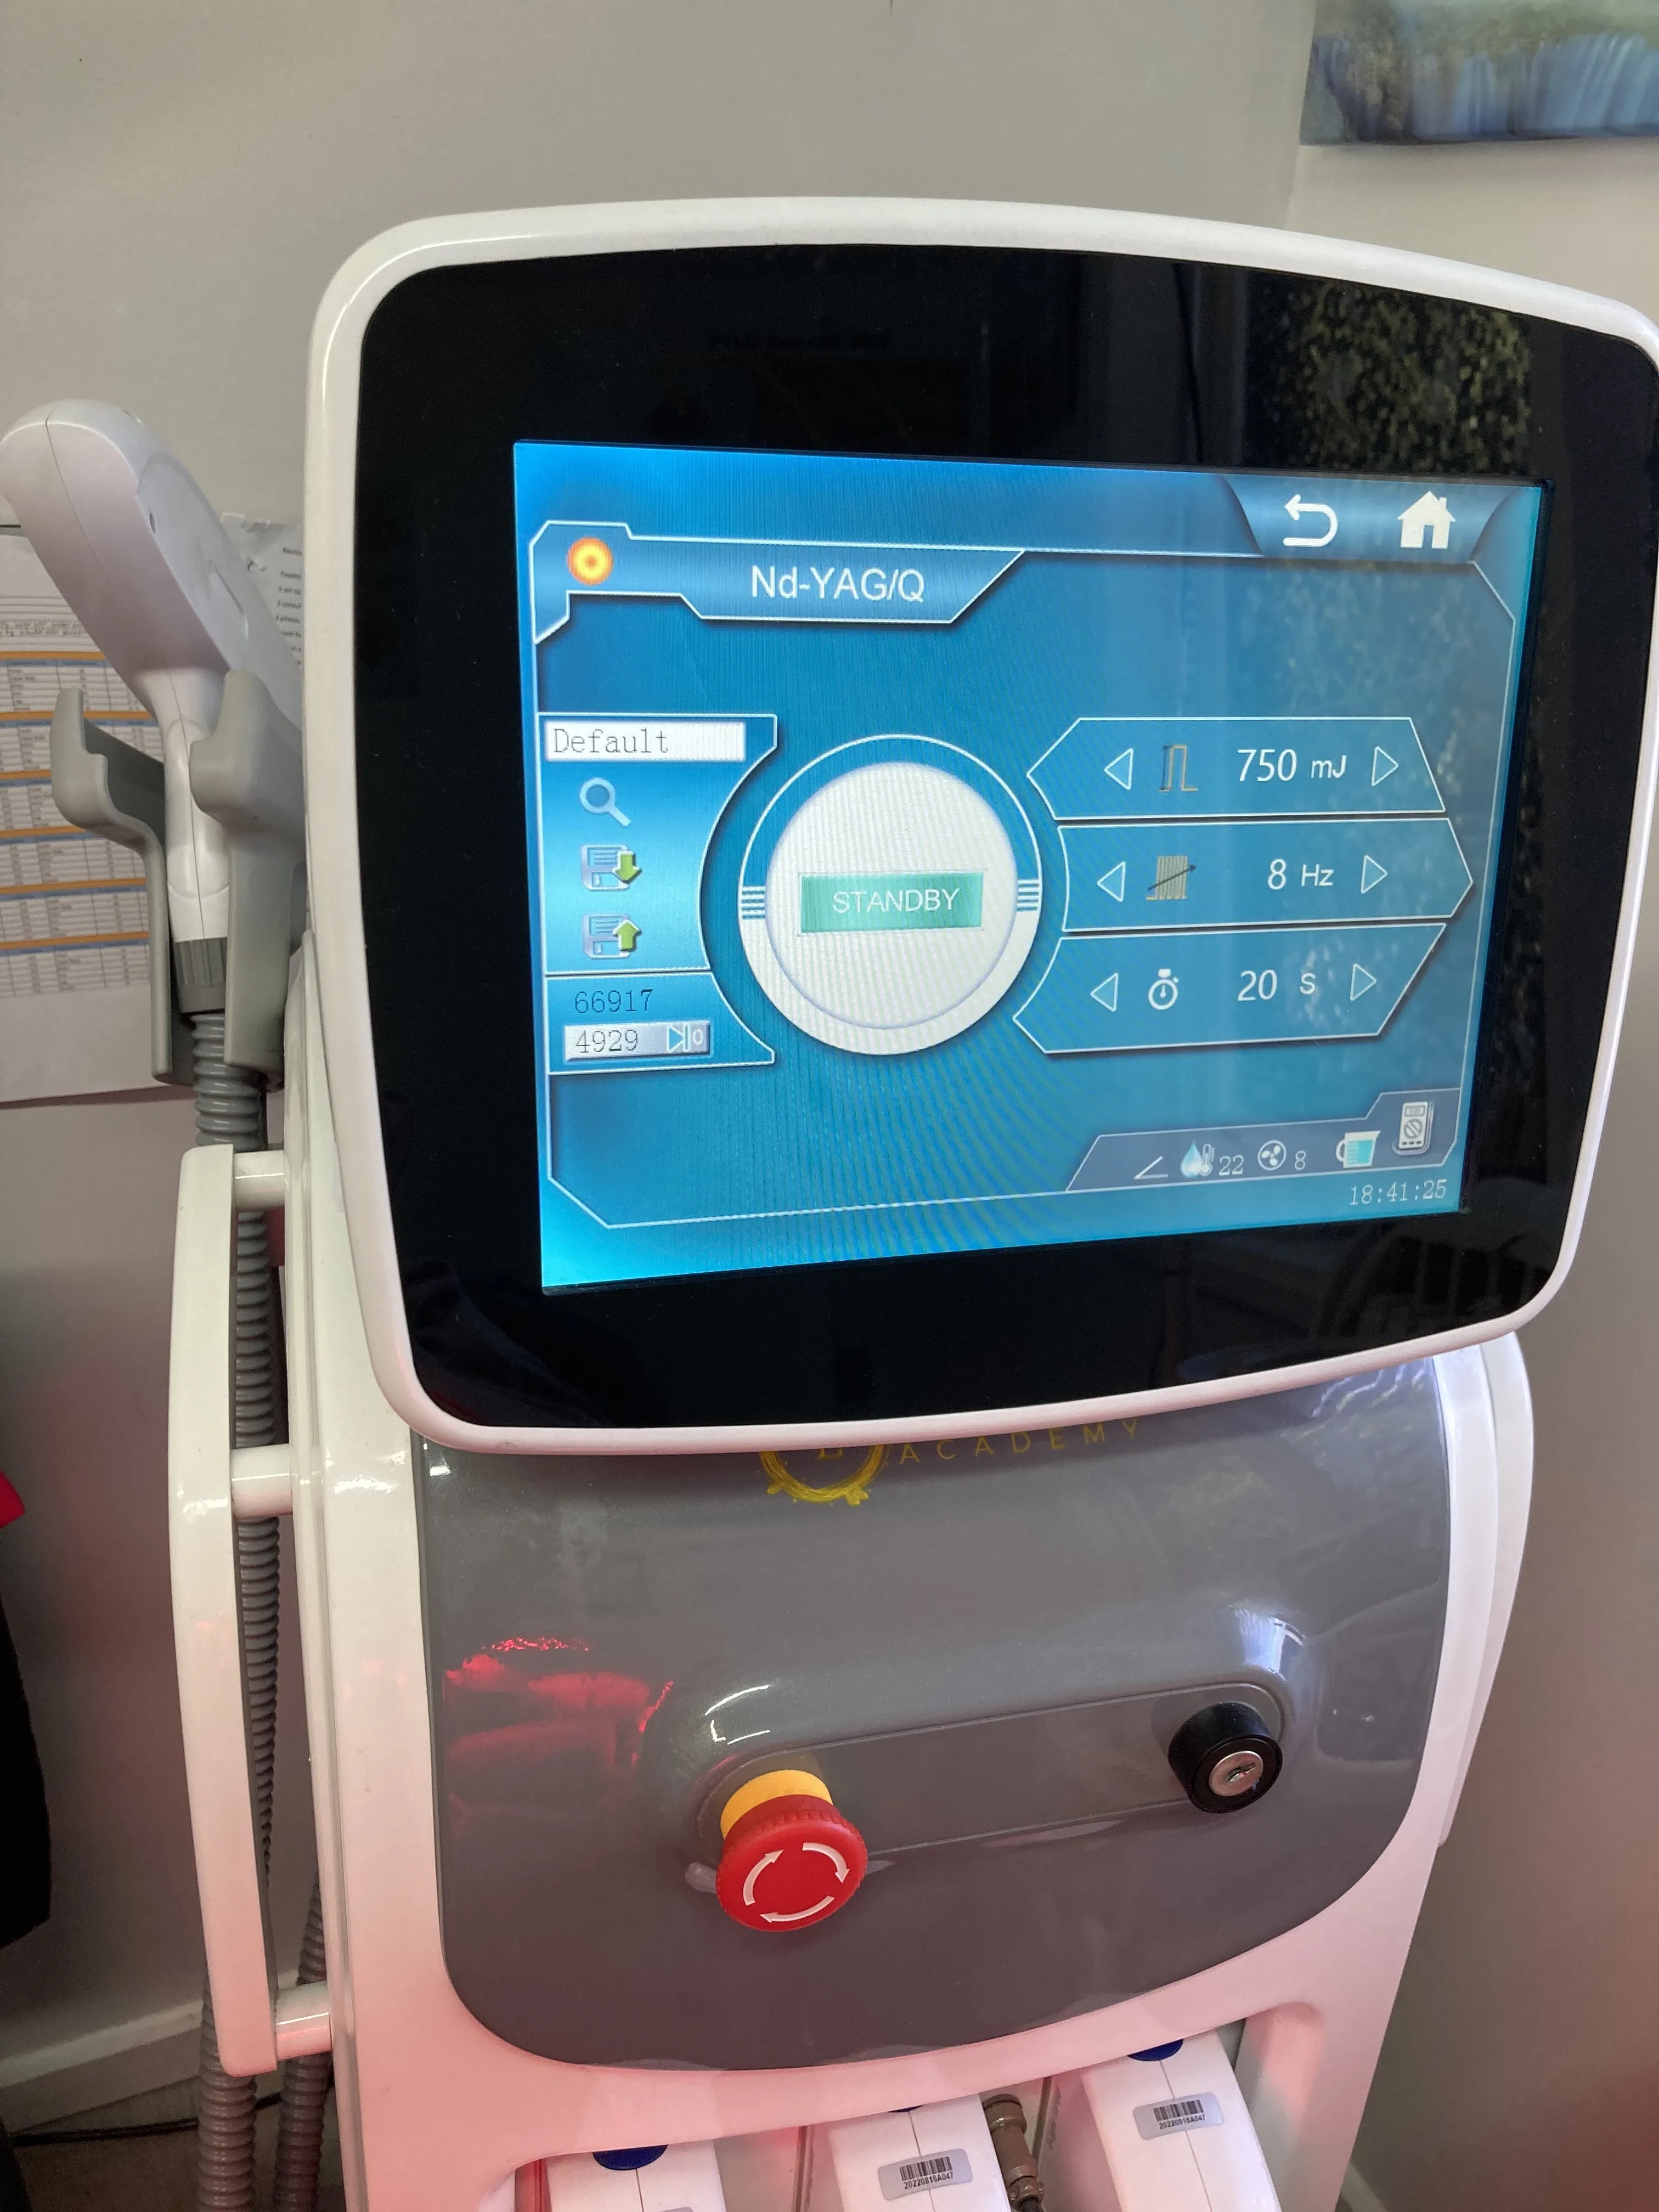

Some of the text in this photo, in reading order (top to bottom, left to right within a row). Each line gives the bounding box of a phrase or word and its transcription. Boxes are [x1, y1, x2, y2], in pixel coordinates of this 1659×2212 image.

[751, 566, 924, 602] Nd-YAG/Q
[553, 728, 669, 754] Default
[1237, 749, 1347, 782] 750 mJ
[1267, 859, 1334, 890] 8 Hz
[832, 888, 961, 913] STANDBY
[1237, 969, 1278, 1001] 20
[574, 989, 653, 1013] 66917
[575, 1030, 639, 1053] 4929
[1218, 1154, 1244, 1176] 22
[1294, 1150, 1307, 1171] 8
[1349, 1179, 1448, 1206] 18:41:25
[899, 1417, 1138, 1465] ACADEMY
[903, 2171, 953, 2190] 20220816A047
